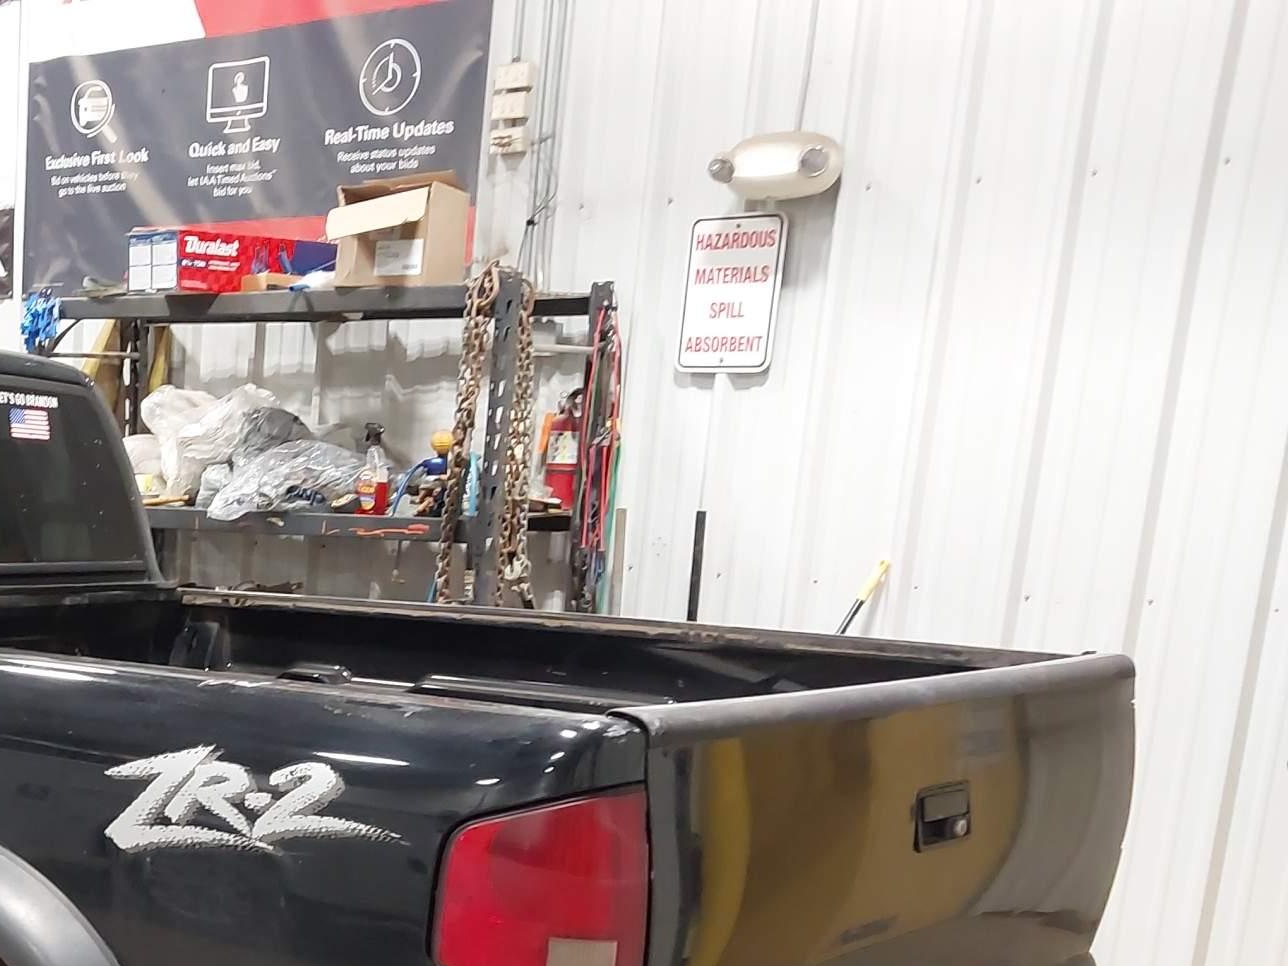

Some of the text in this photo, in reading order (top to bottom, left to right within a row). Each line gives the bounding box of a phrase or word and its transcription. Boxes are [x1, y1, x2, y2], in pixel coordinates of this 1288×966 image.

[324, 120, 455, 145] Real-Time Updates
[188, 136, 281, 158] Quick and Easy
[337, 145, 436, 162] Receive status updates
[45, 147, 149, 170] Exclusive First Look
[350, 158, 419, 174] about your bids
[184, 235, 240, 257] Duralast
[695, 229, 777, 251] HAZARDOUS
[694, 265, 770, 285] MATERIALS
[709, 301, 745, 319] SPILL
[685, 335, 763, 353] ABSORBENT
[15, 393, 25, 406] GO
[26, 394, 58, 408] BRANDON
